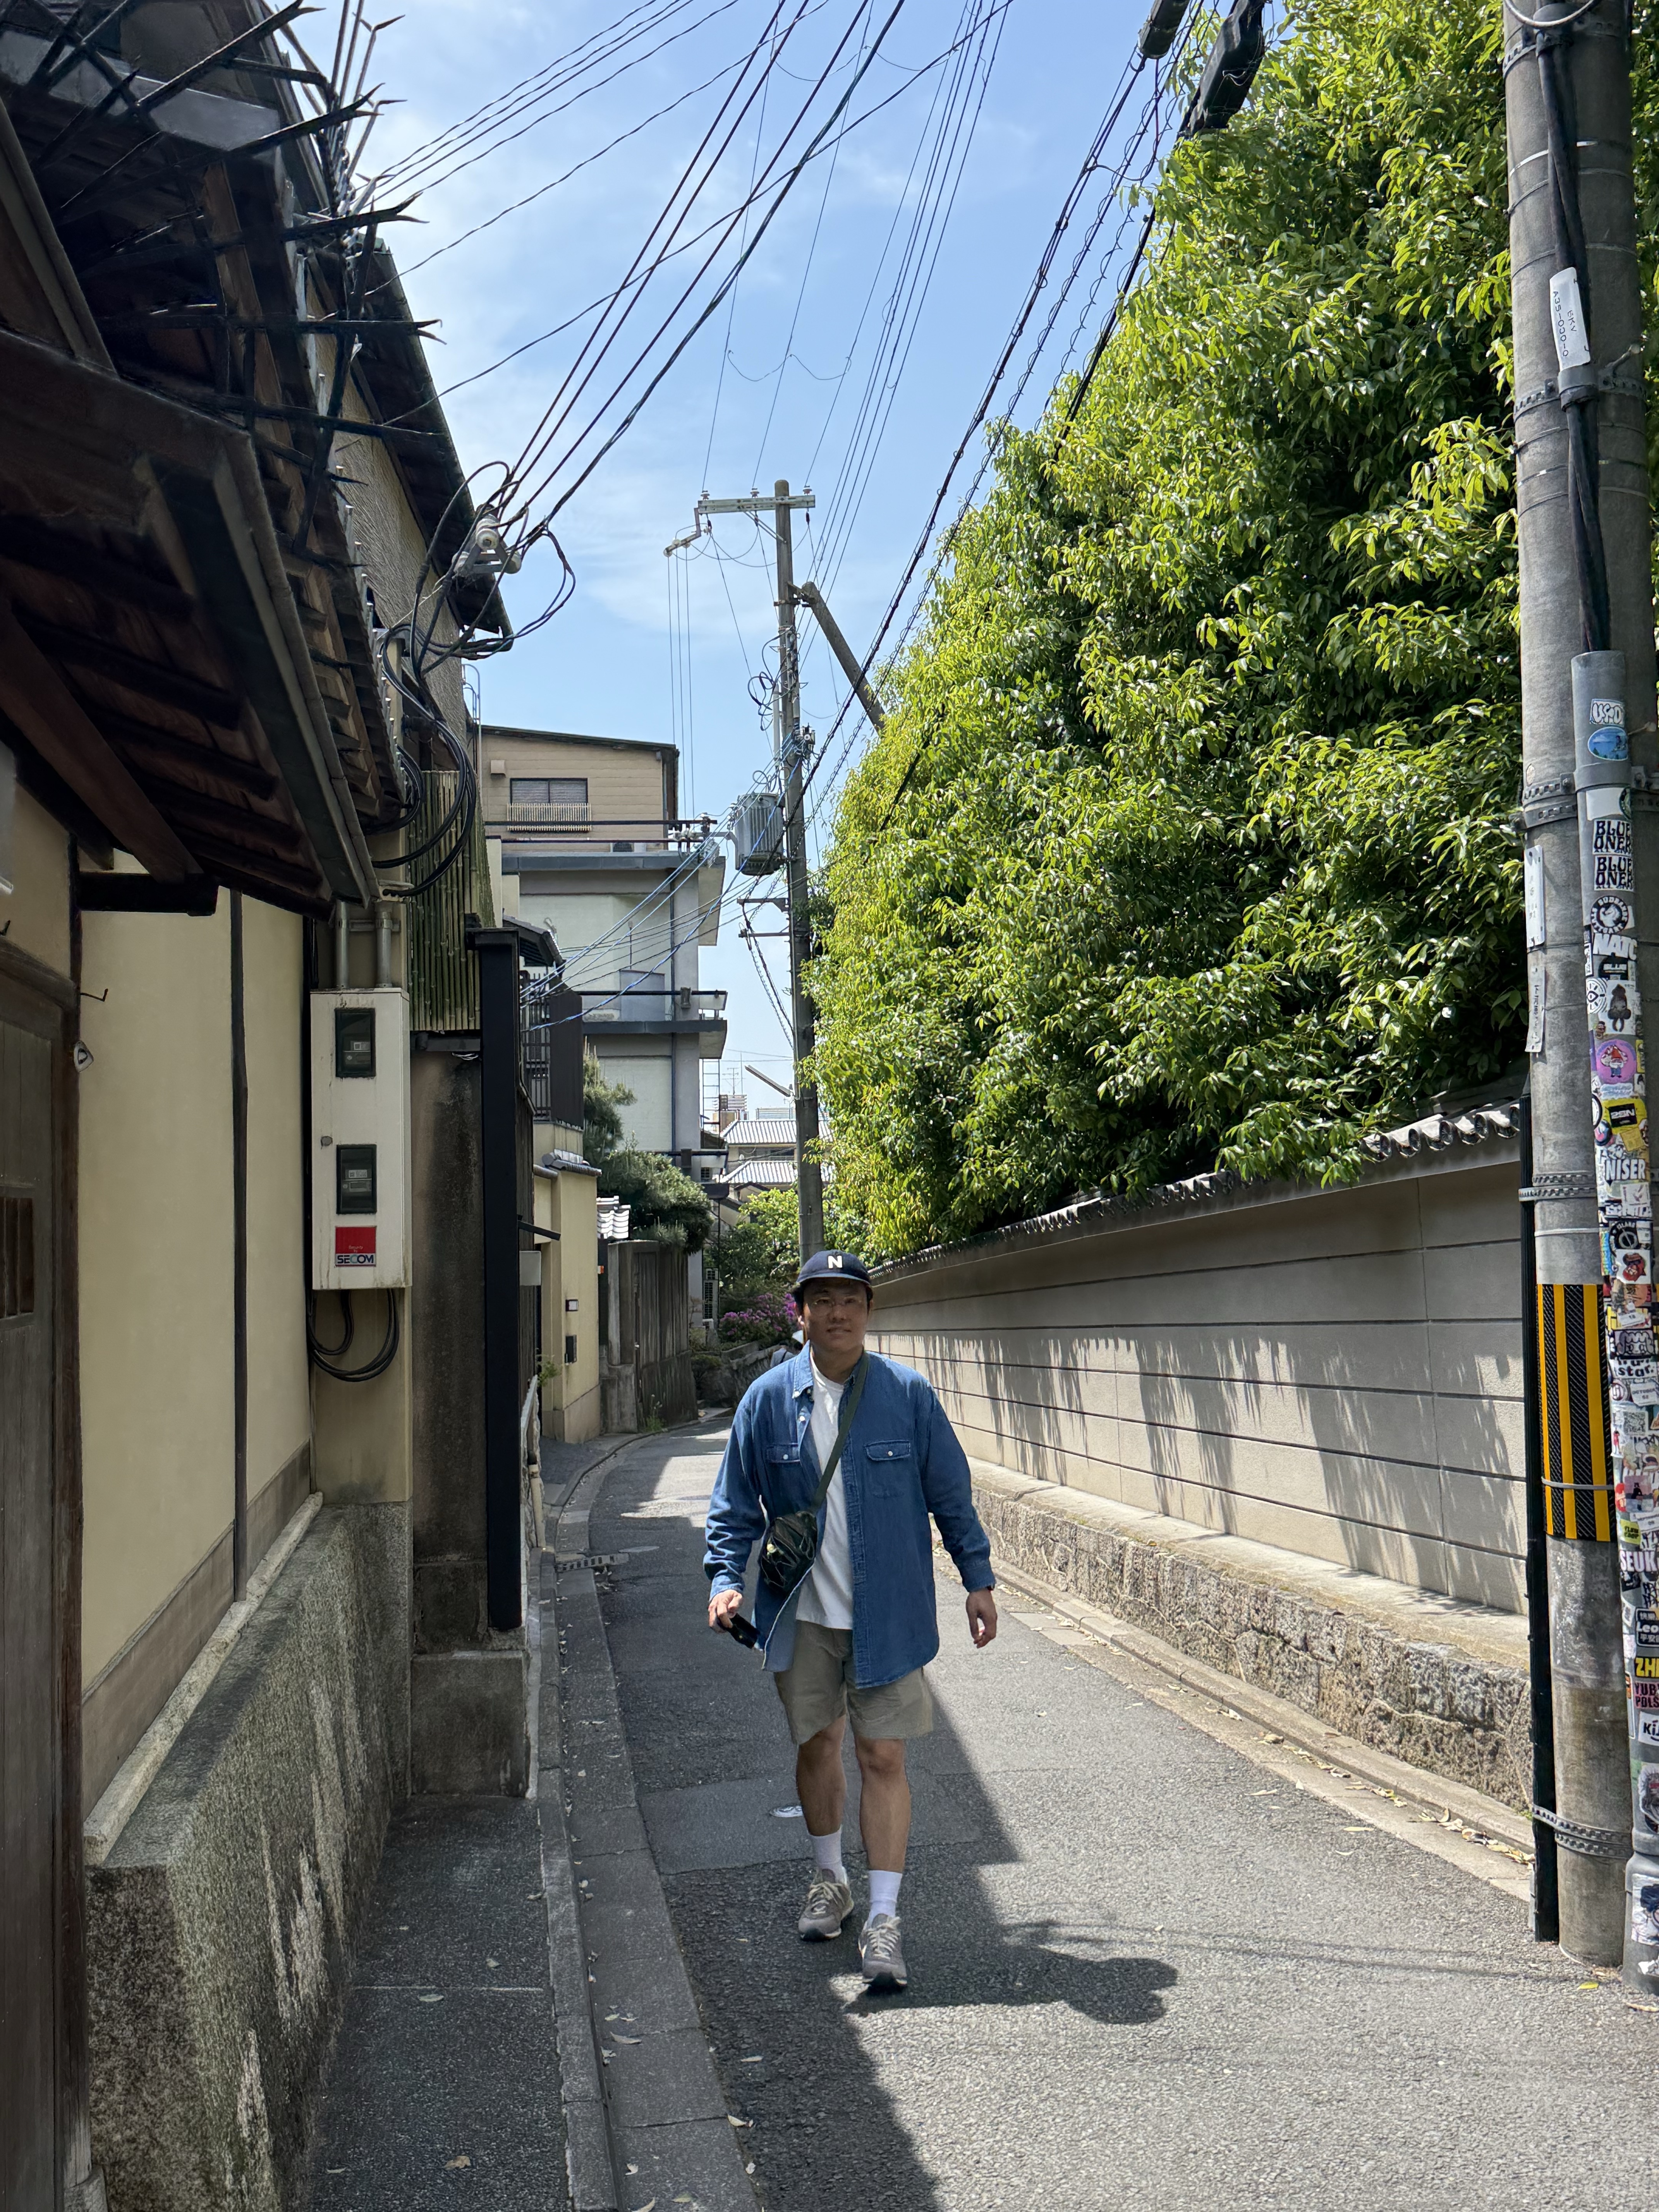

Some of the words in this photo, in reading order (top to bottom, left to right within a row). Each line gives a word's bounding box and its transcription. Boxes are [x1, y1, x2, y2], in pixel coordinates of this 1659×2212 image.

[1606, 1159, 1645, 1180] NISER
[337, 1254, 374, 1264] SECOM
[828, 1255, 843, 1268] N
